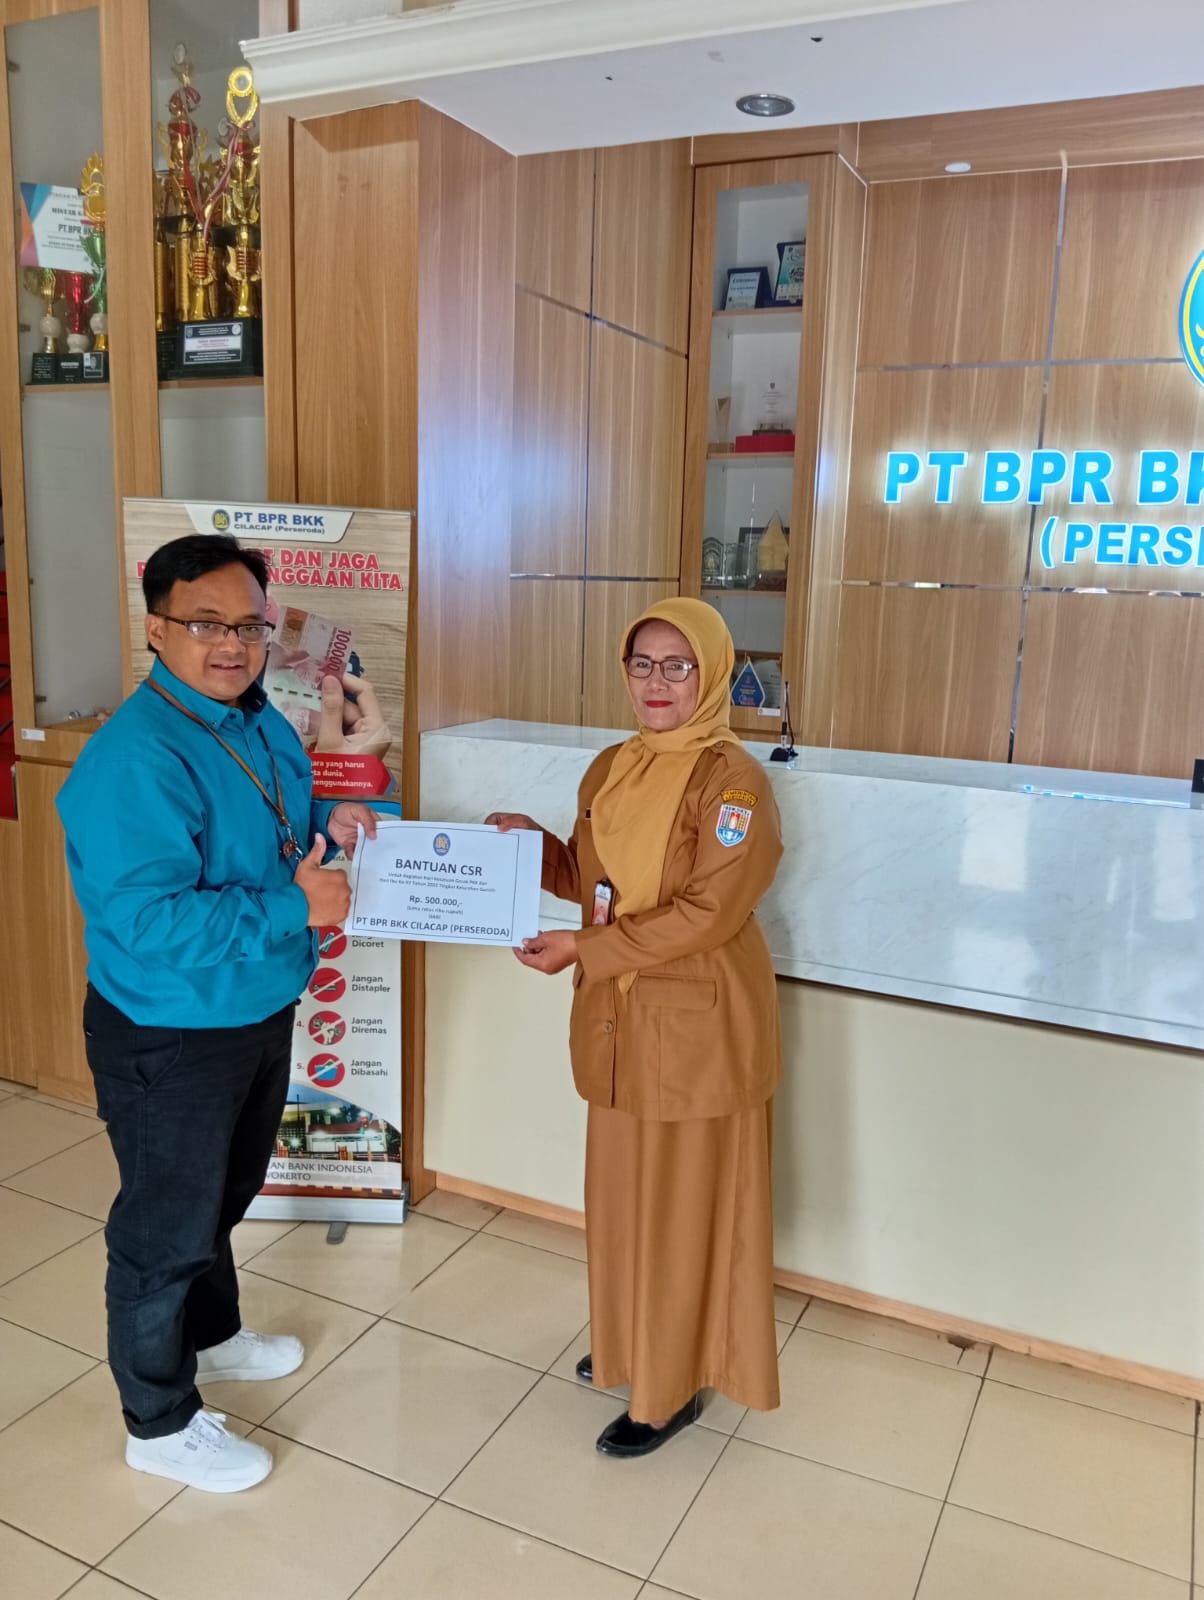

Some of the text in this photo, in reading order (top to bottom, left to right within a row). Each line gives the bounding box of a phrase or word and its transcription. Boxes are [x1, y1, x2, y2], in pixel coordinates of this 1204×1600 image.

[883, 450, 969, 504] PT
[981, 449, 1114, 506] BPR
[234, 511, 325, 527] PT BPR BKK
[233, 523, 326, 535] CILACAP (Perseroda)
[1039, 515, 1204, 569] (PERS
[280, 550, 323, 569] DAN
[328, 552, 379, 571] JAGA
[267, 568, 403, 591] NGGAAN KITA
[327, 629, 352, 671] 100000
[325, 761, 343, 769] yang
[344, 761, 365, 769] harus
[395, 858, 483, 877] BANTUAN CSR
[409, 895, 463, 908] Rp. 500.000,-
[355, 916, 510, 938] PT BPR BKK CILACAP (PERSERODA)
[351, 939, 385, 949] Dicoret
[351, 975, 384, 984] Jangan
[351, 983, 391, 993] Distapler
[351, 1016, 383, 1026] Jangan
[351, 1026, 388, 1035] Diremas
[350, 1059, 382, 1068] Jangan
[350, 1068, 388, 1077] Dibasahi
[288, 1162, 315, 1171] BANK
[317, 1164, 373, 1174] INDONESIA
